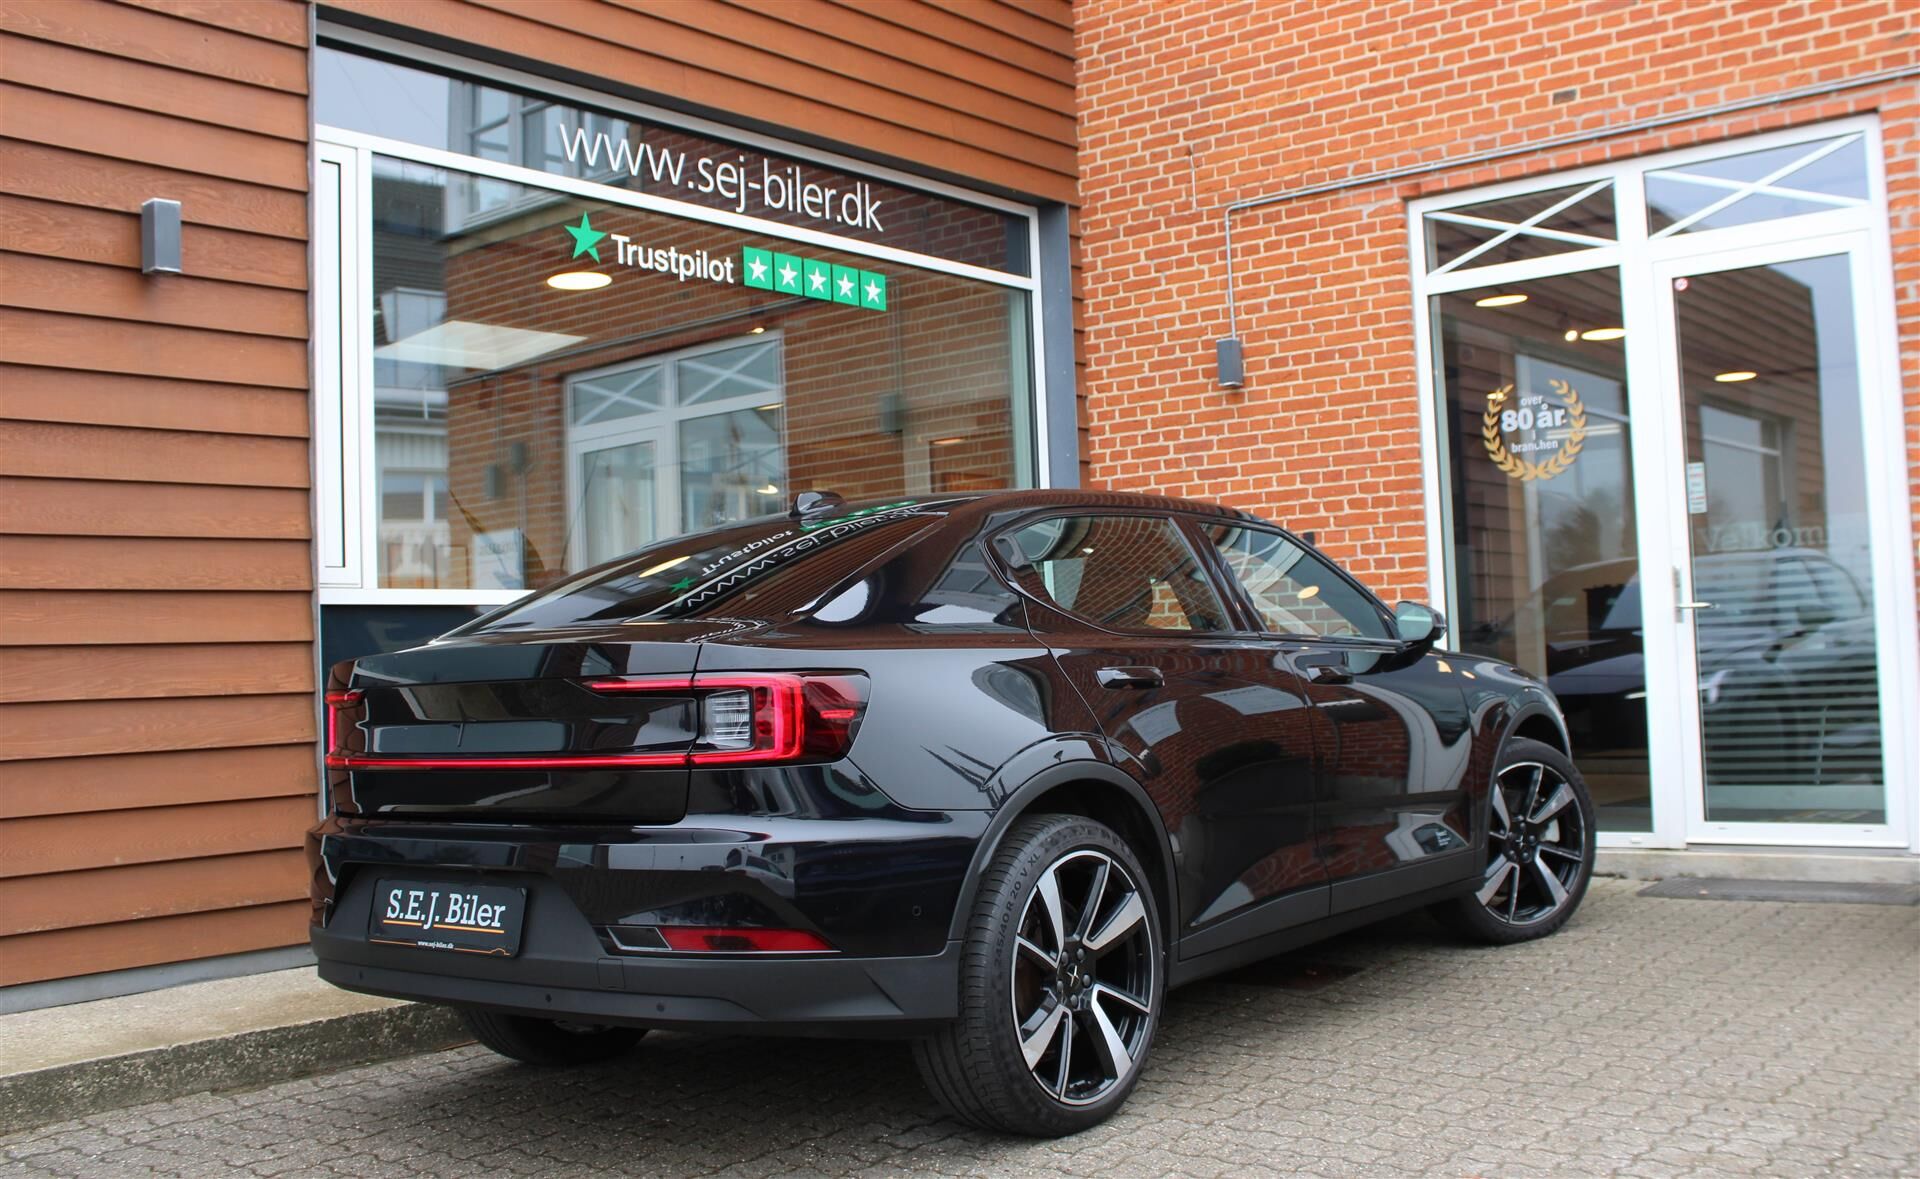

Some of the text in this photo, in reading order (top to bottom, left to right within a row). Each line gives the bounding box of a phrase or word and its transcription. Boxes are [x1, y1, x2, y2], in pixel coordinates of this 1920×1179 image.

[559, 123, 884, 232] www.sej-biler.dk
[610, 234, 734, 284] Trustpilot
[1520, 395, 1544, 406] over
[1501, 408, 1534, 432] 80
[1027, 852, 1041, 867] XL
[1019, 868, 1028, 878] V
[1009, 880, 1022, 899] 20
[386, 889, 506, 930] S.E.J. Biler
[1006, 901, 1015, 912] R
